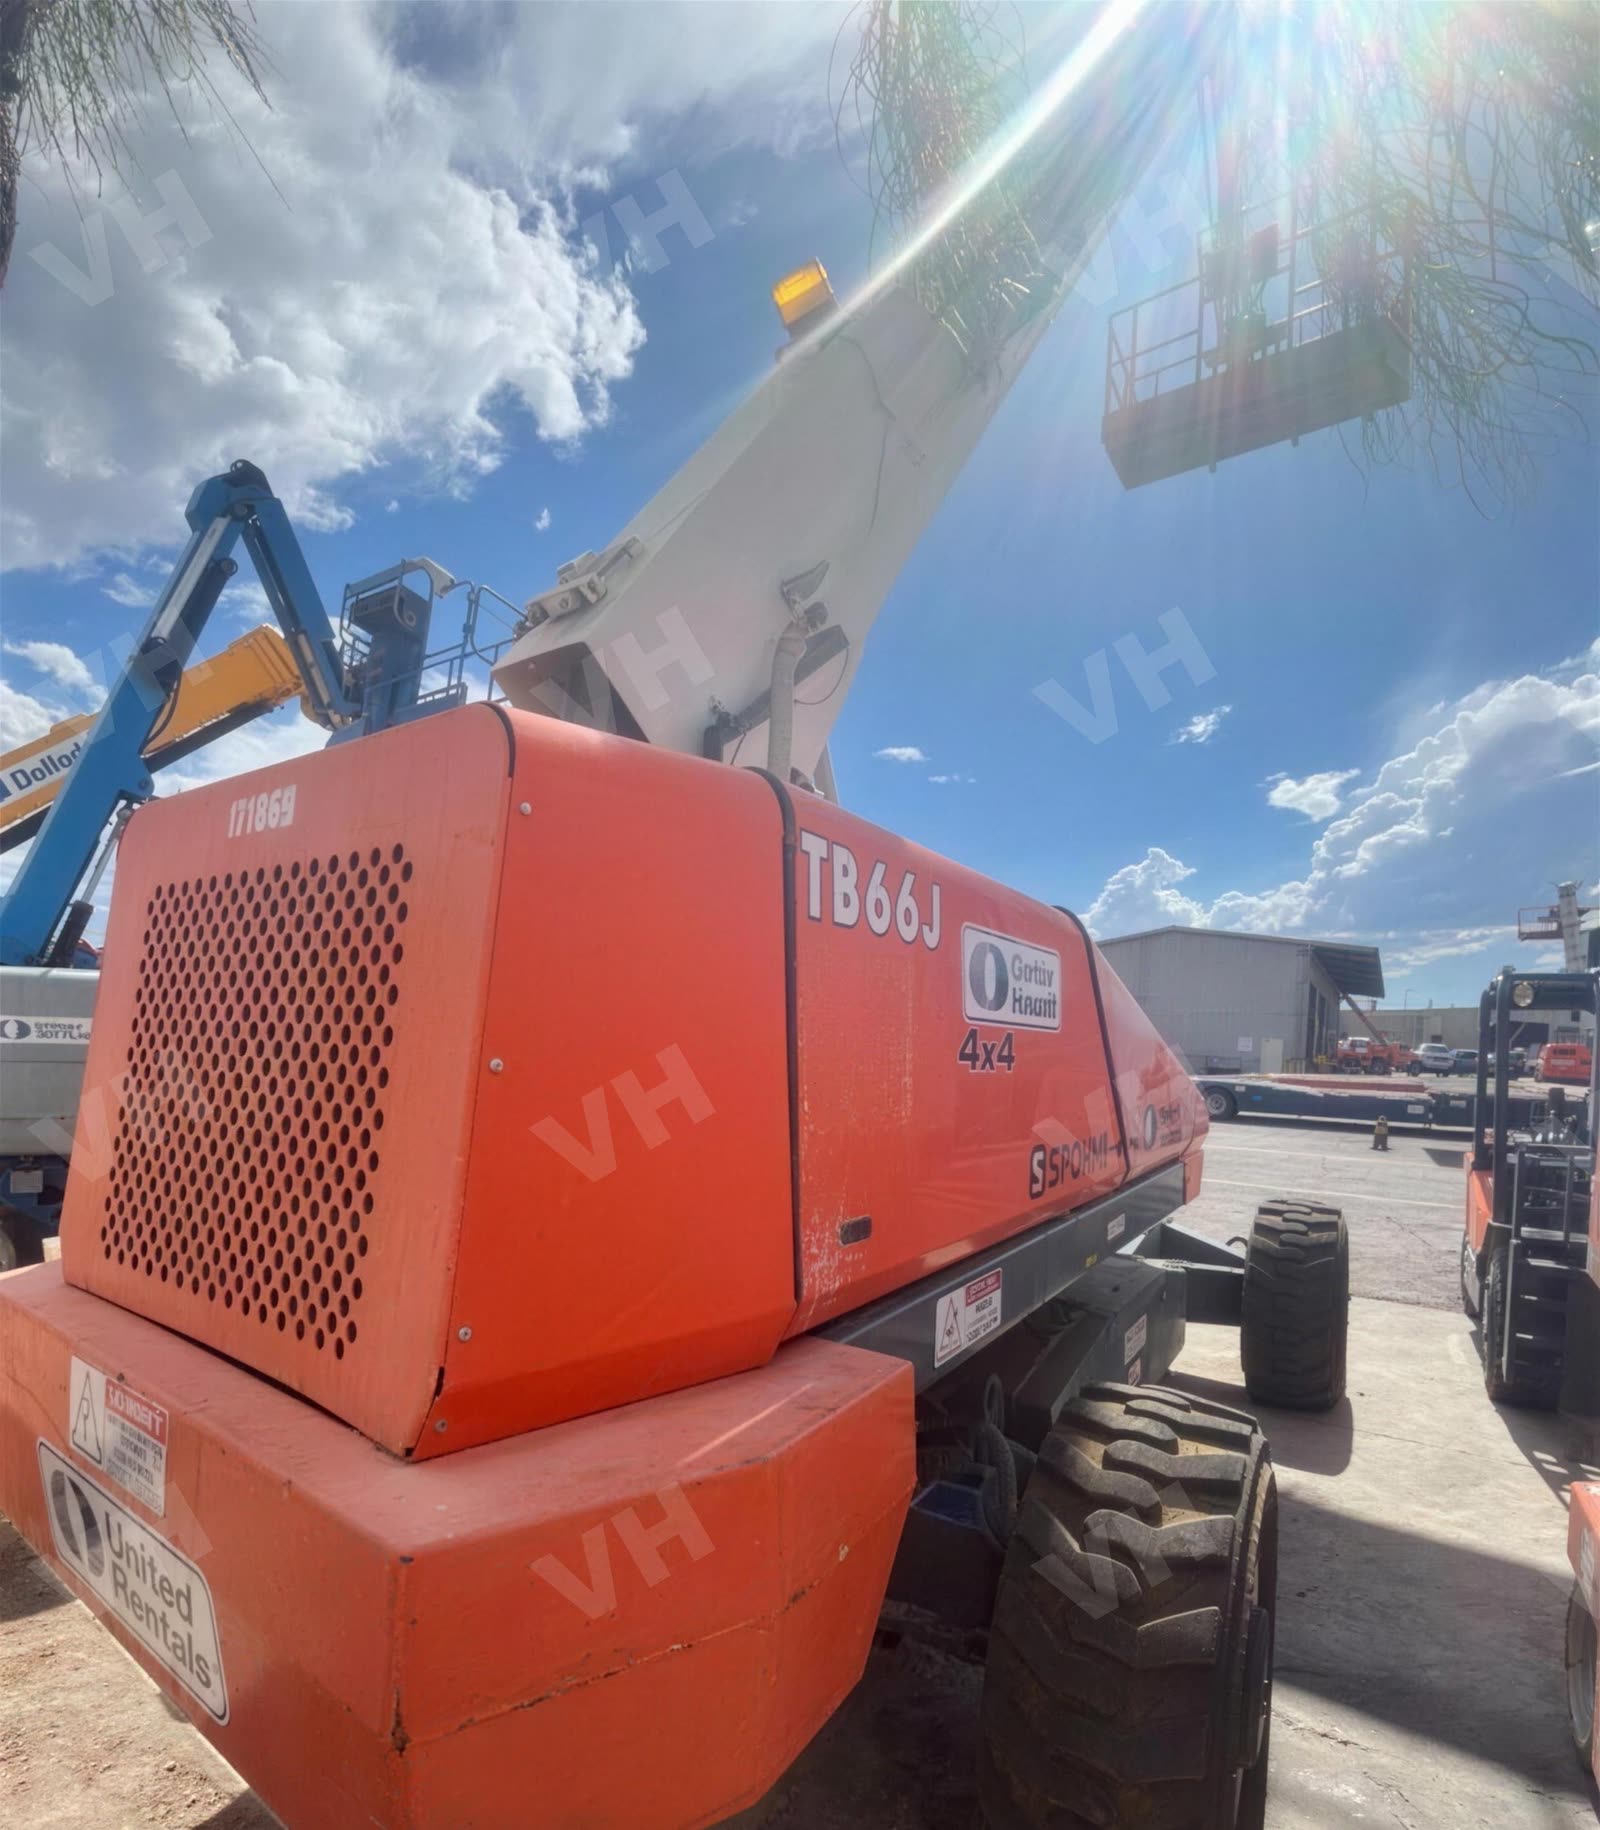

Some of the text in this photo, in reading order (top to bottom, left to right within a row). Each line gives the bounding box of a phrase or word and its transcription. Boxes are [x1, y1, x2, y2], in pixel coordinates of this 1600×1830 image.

[800, 828, 941, 951] TB66J
[958, 1027, 1016, 1072] 4x4
[105, 1511, 194, 1627] United
[112, 1560, 212, 1689] Rentals
